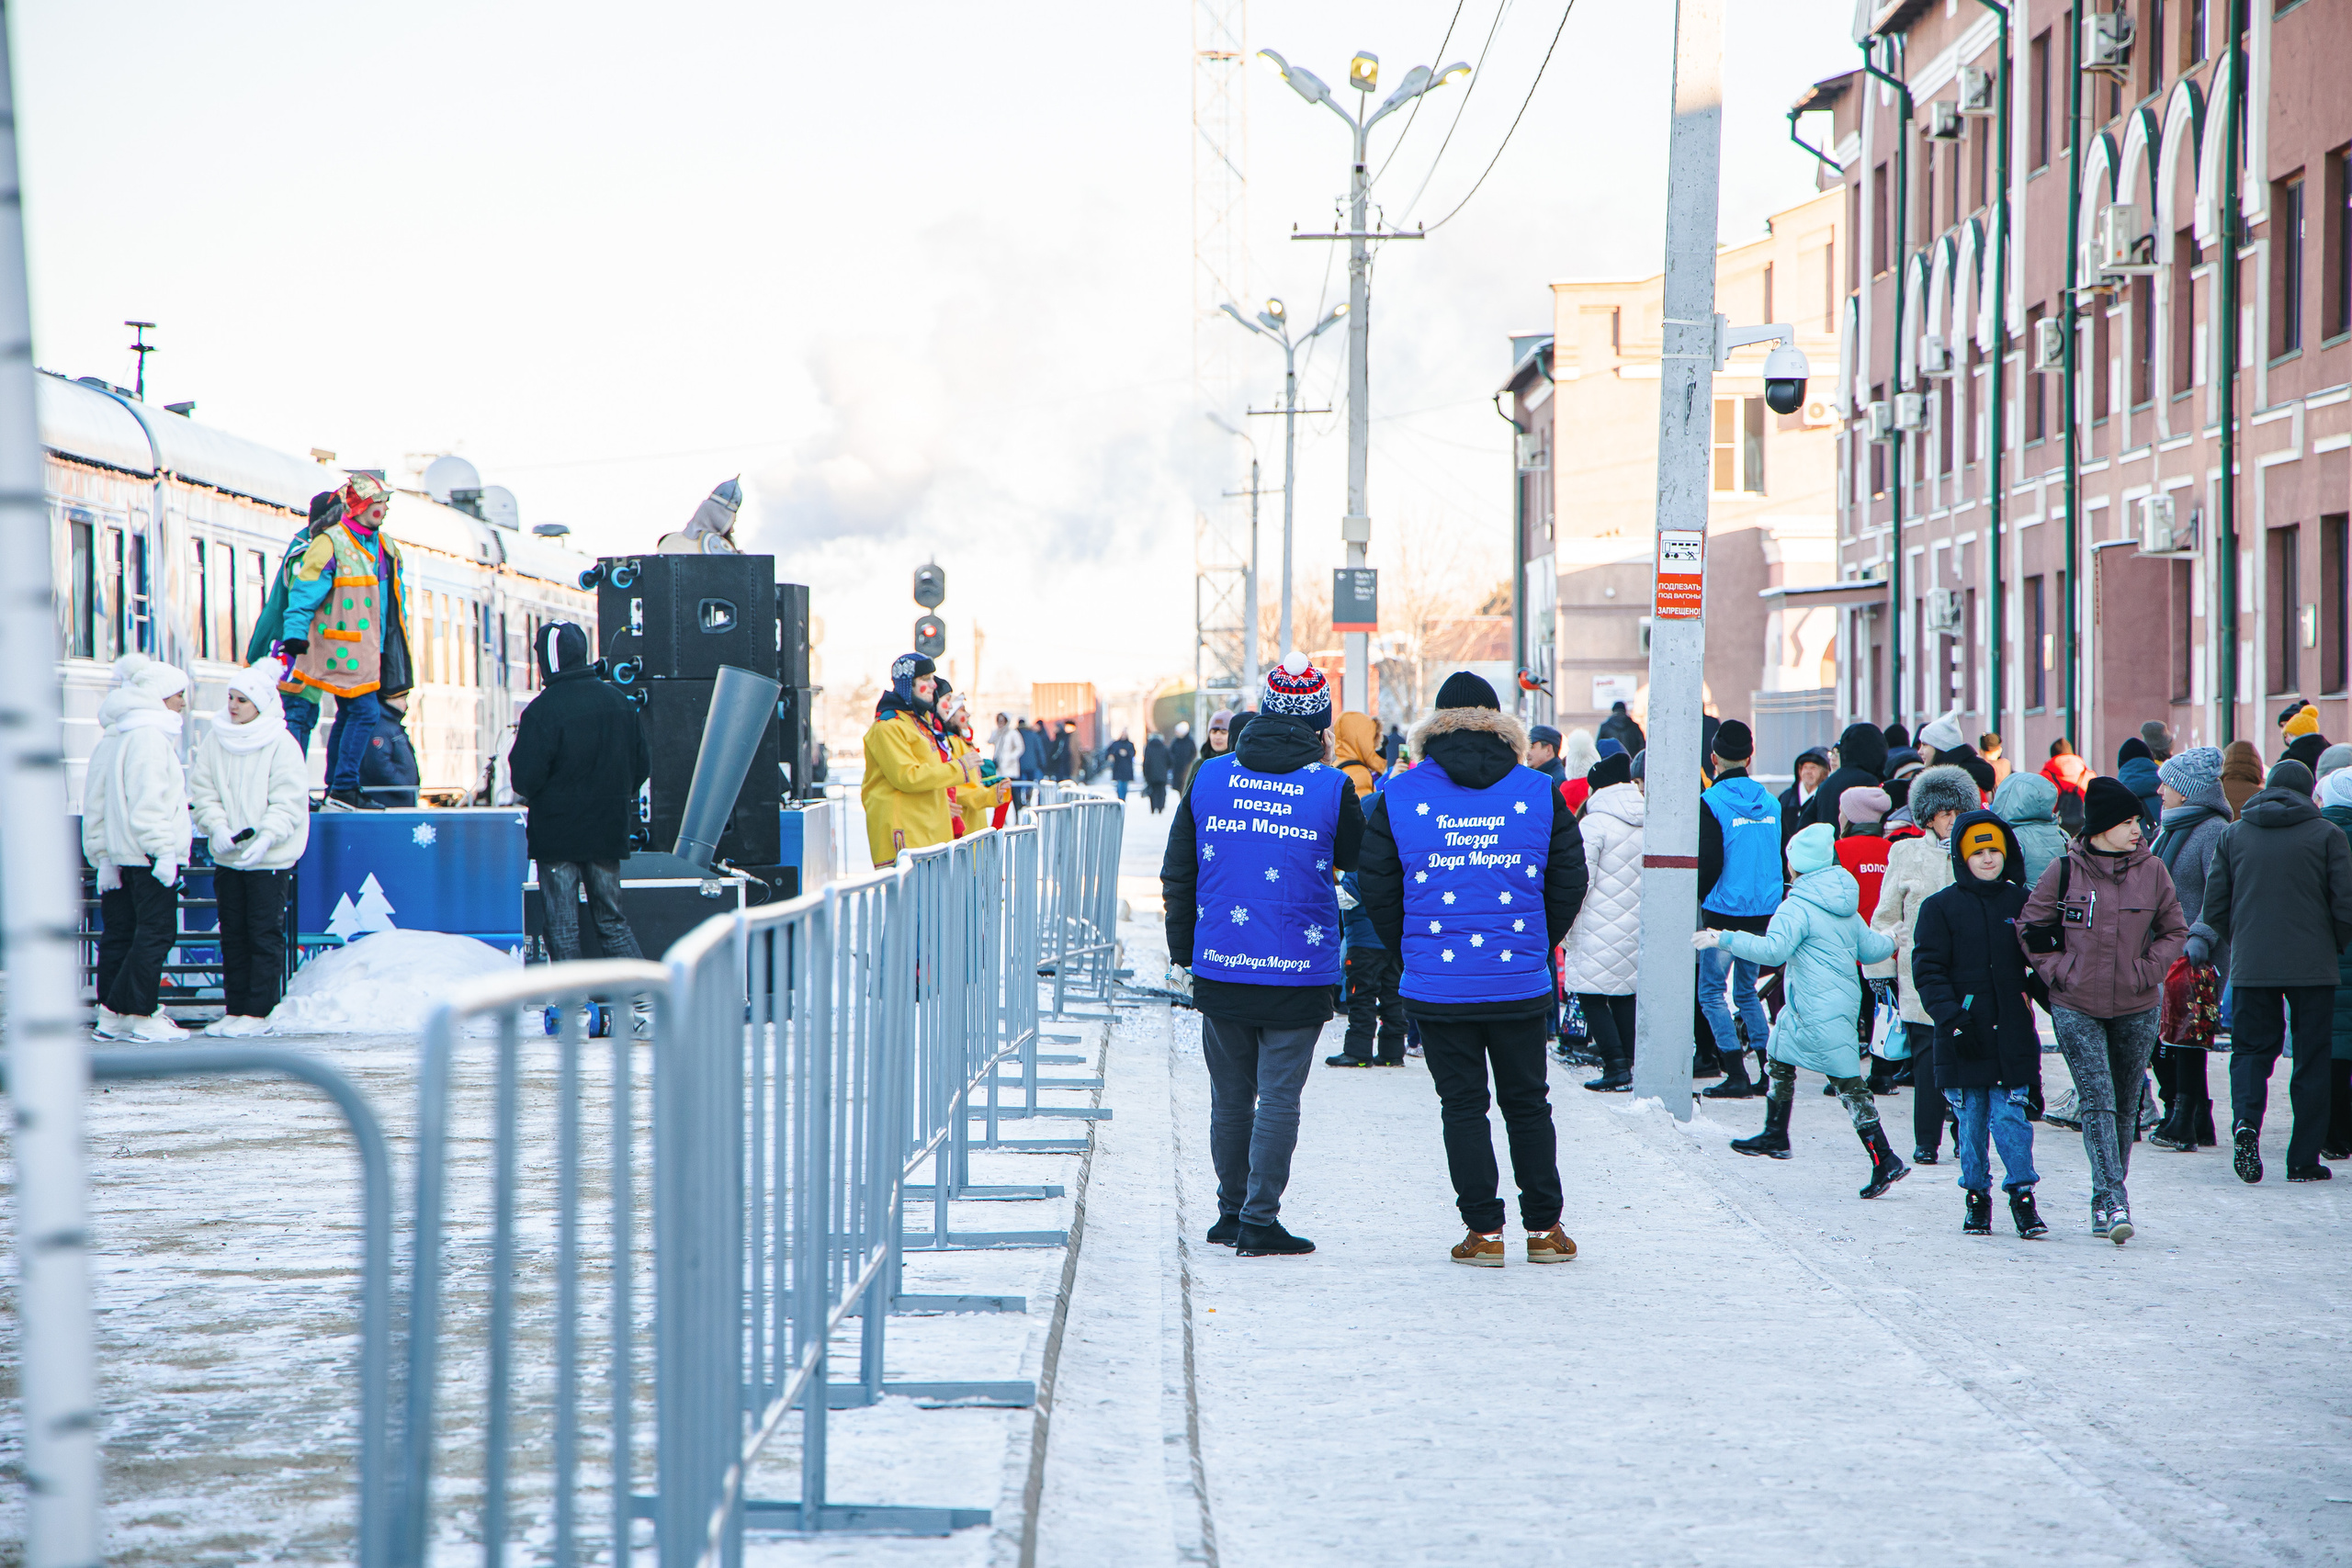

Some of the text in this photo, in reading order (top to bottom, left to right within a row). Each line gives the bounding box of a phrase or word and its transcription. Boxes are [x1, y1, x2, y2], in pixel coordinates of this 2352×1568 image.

[1658, 582, 1702, 591] ПОДЛЕЗАТЬ
[1657, 606, 1702, 615] ЗАПРЕЩЕНО!
[1228, 774, 1305, 796] Команда
[1233, 798, 1293, 816] поезда
[1205, 815, 1317, 841] Деда Мороза
[1436, 814, 1506, 829] Команда
[1444, 831, 1498, 850] Поезда
[1428, 851, 1521, 870] Деда Мороза
[1860, 863, 1888, 874] ВОЛО
[1203, 948, 1311, 973] #ПоездДедаМороза
